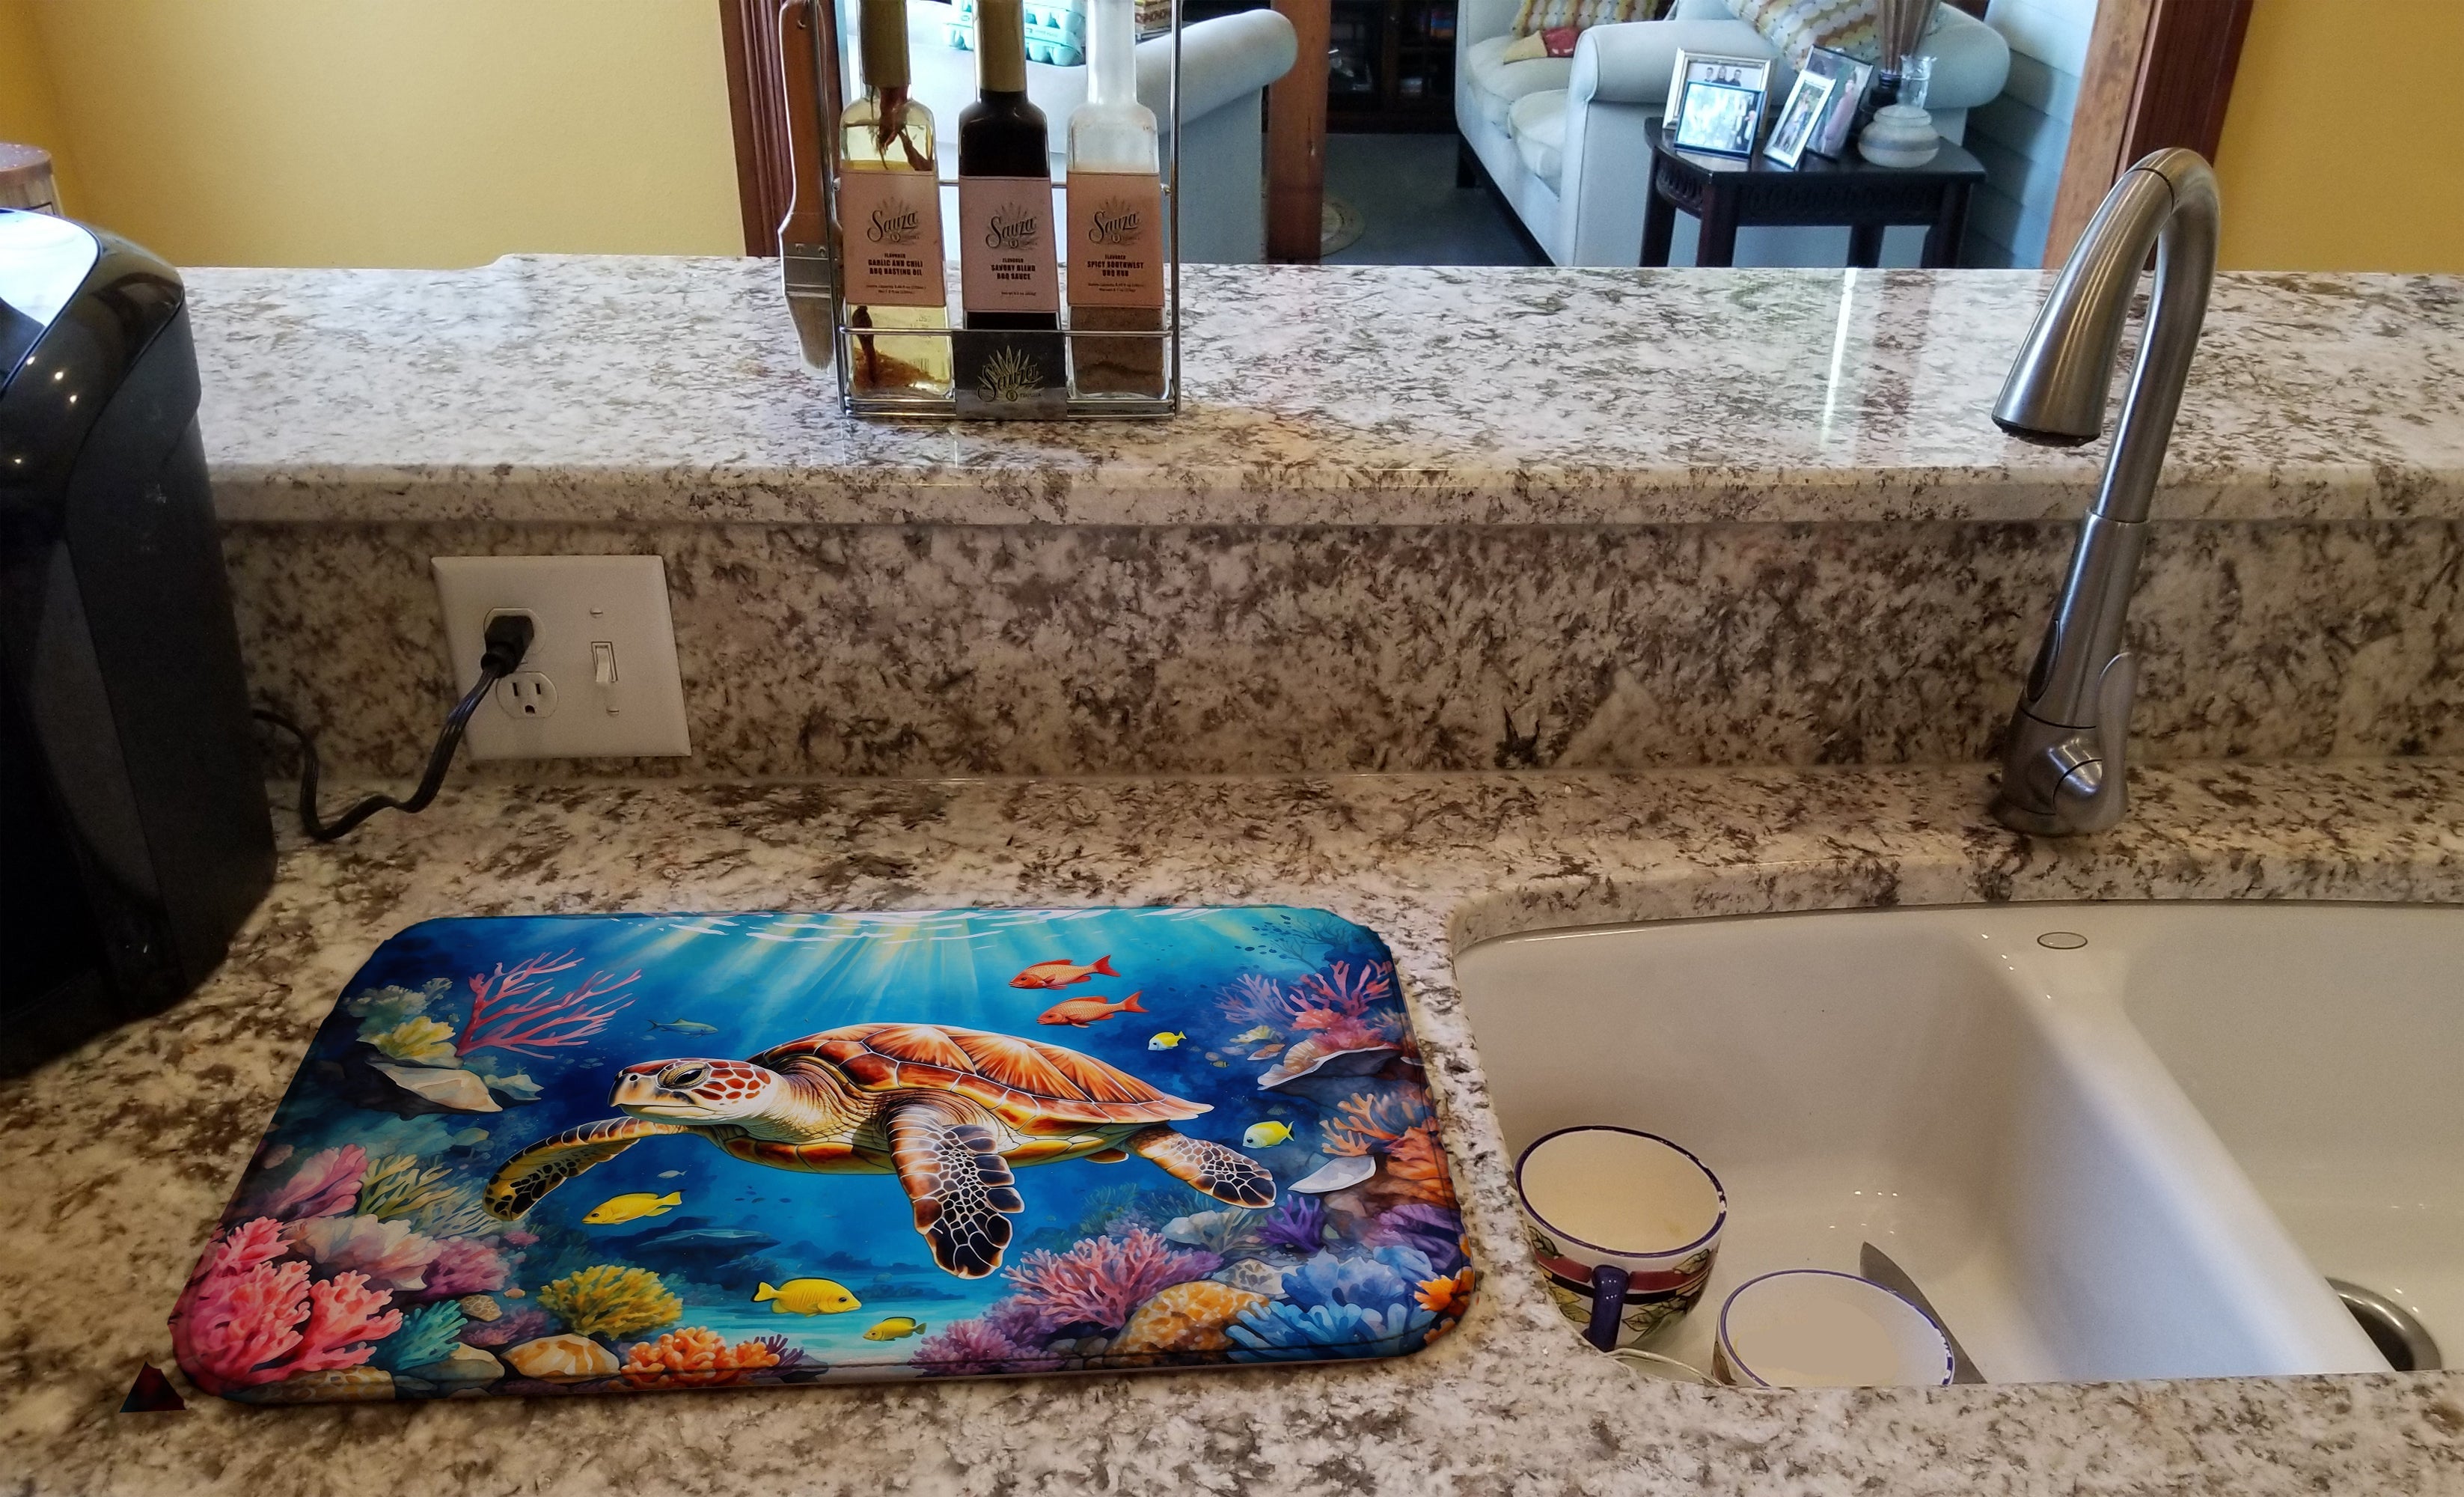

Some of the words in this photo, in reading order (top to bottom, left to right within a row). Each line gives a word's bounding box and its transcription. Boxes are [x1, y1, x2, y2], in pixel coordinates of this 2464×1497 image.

[866, 210, 919, 243] Sauza
[985, 216, 1037, 249] Sauza
[1088, 210, 1140, 244] Sauza
[869, 267, 882, 275] BBQ
[977, 364, 1039, 403] Sauza
